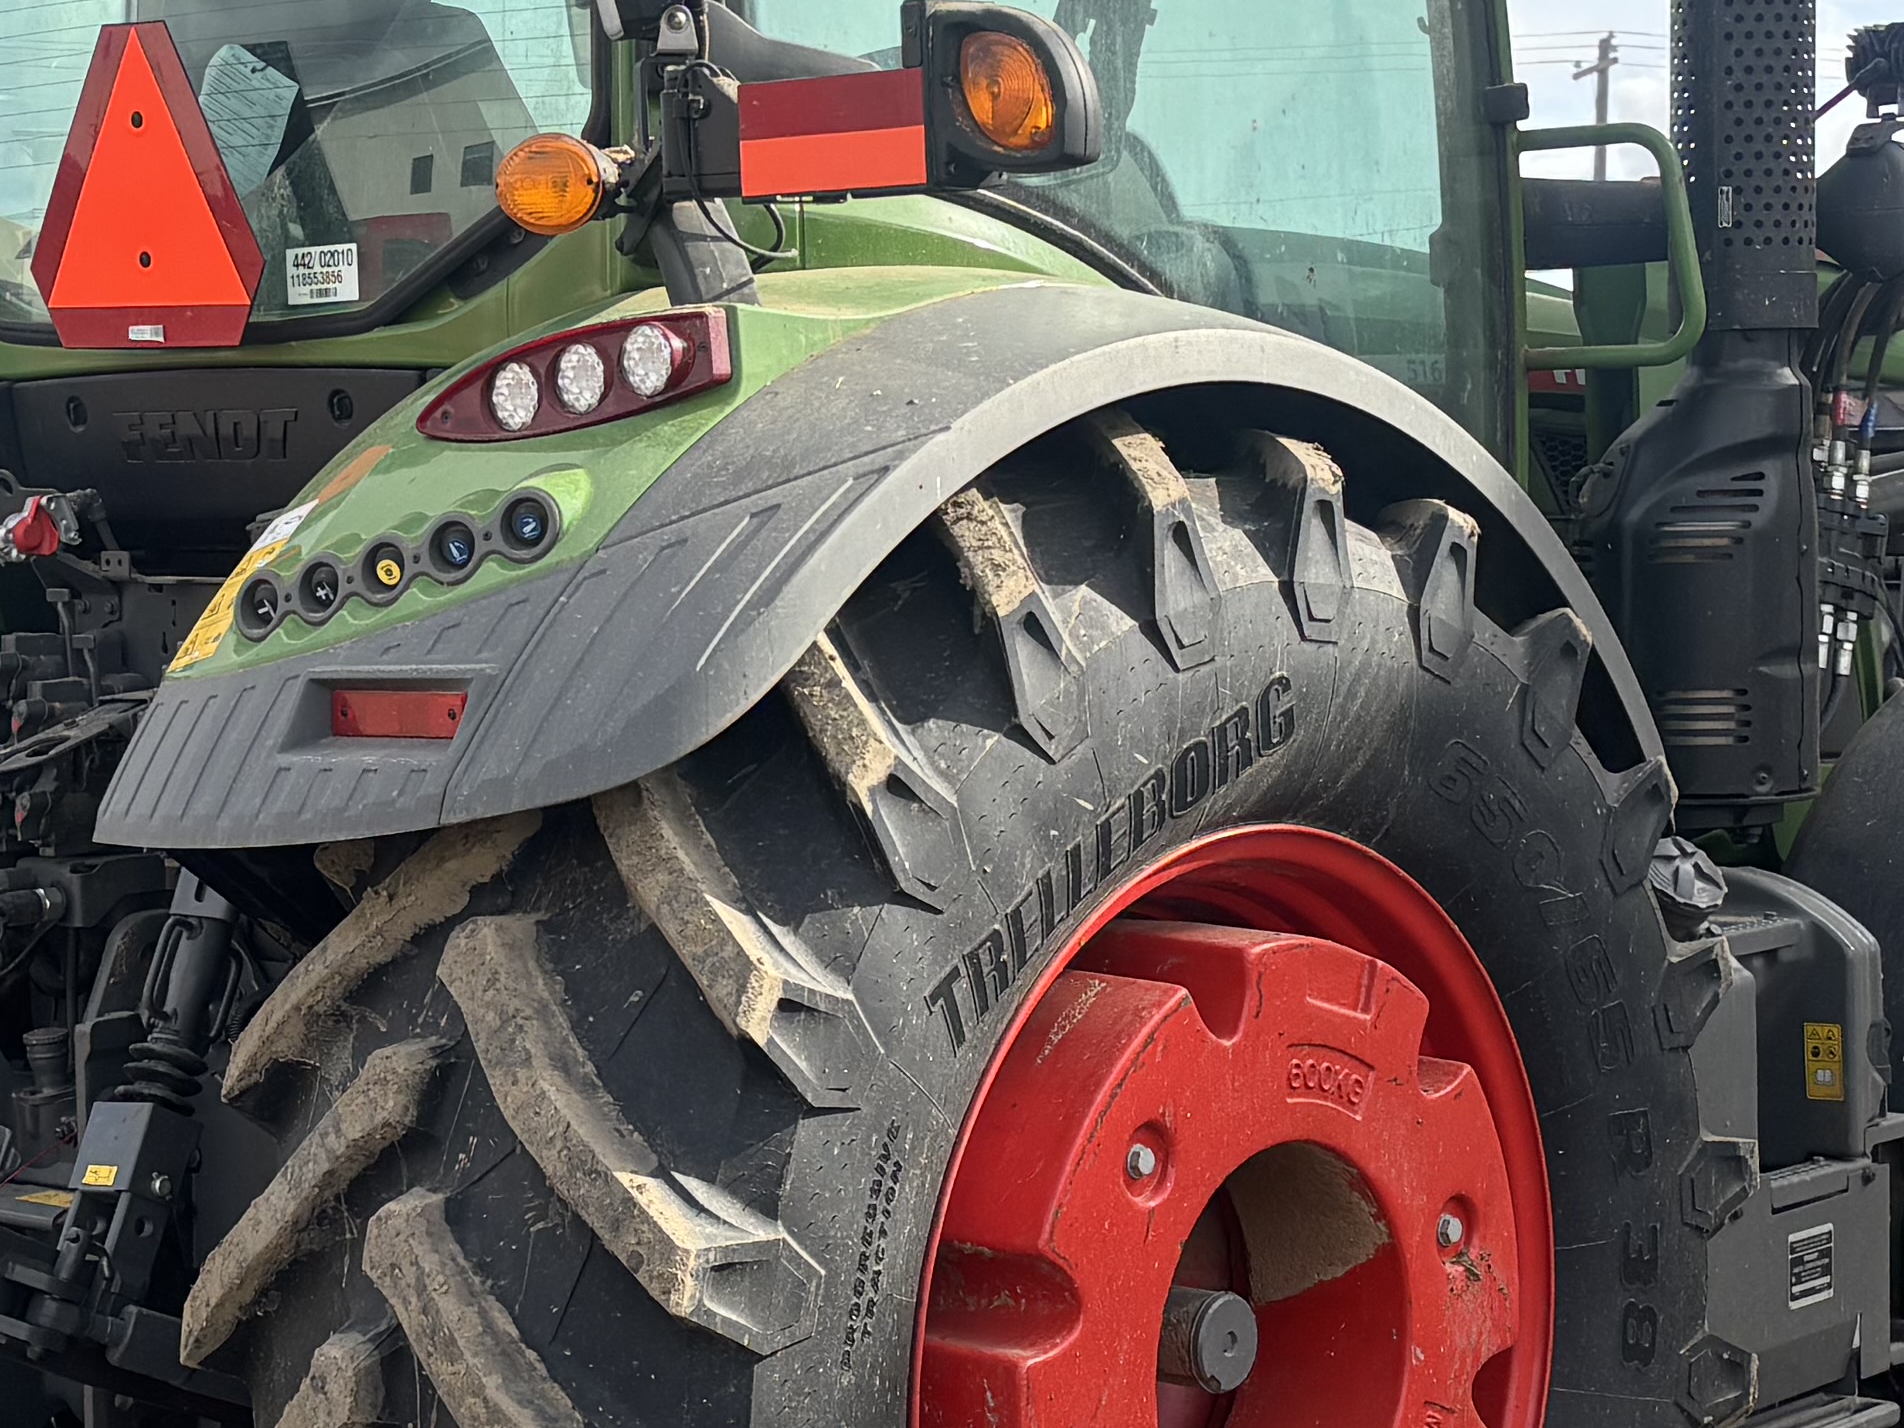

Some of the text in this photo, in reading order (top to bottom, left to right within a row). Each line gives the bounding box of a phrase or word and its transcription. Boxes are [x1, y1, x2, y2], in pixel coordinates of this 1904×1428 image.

[290, 270, 343, 288] 118553856
[112, 409, 298, 464] FENDT
[923, 672, 1296, 1059] TRELLEBORG
[841, 1118, 901, 1372] PROGRESSIVE
[860, 1160, 904, 1343] TRACTION
